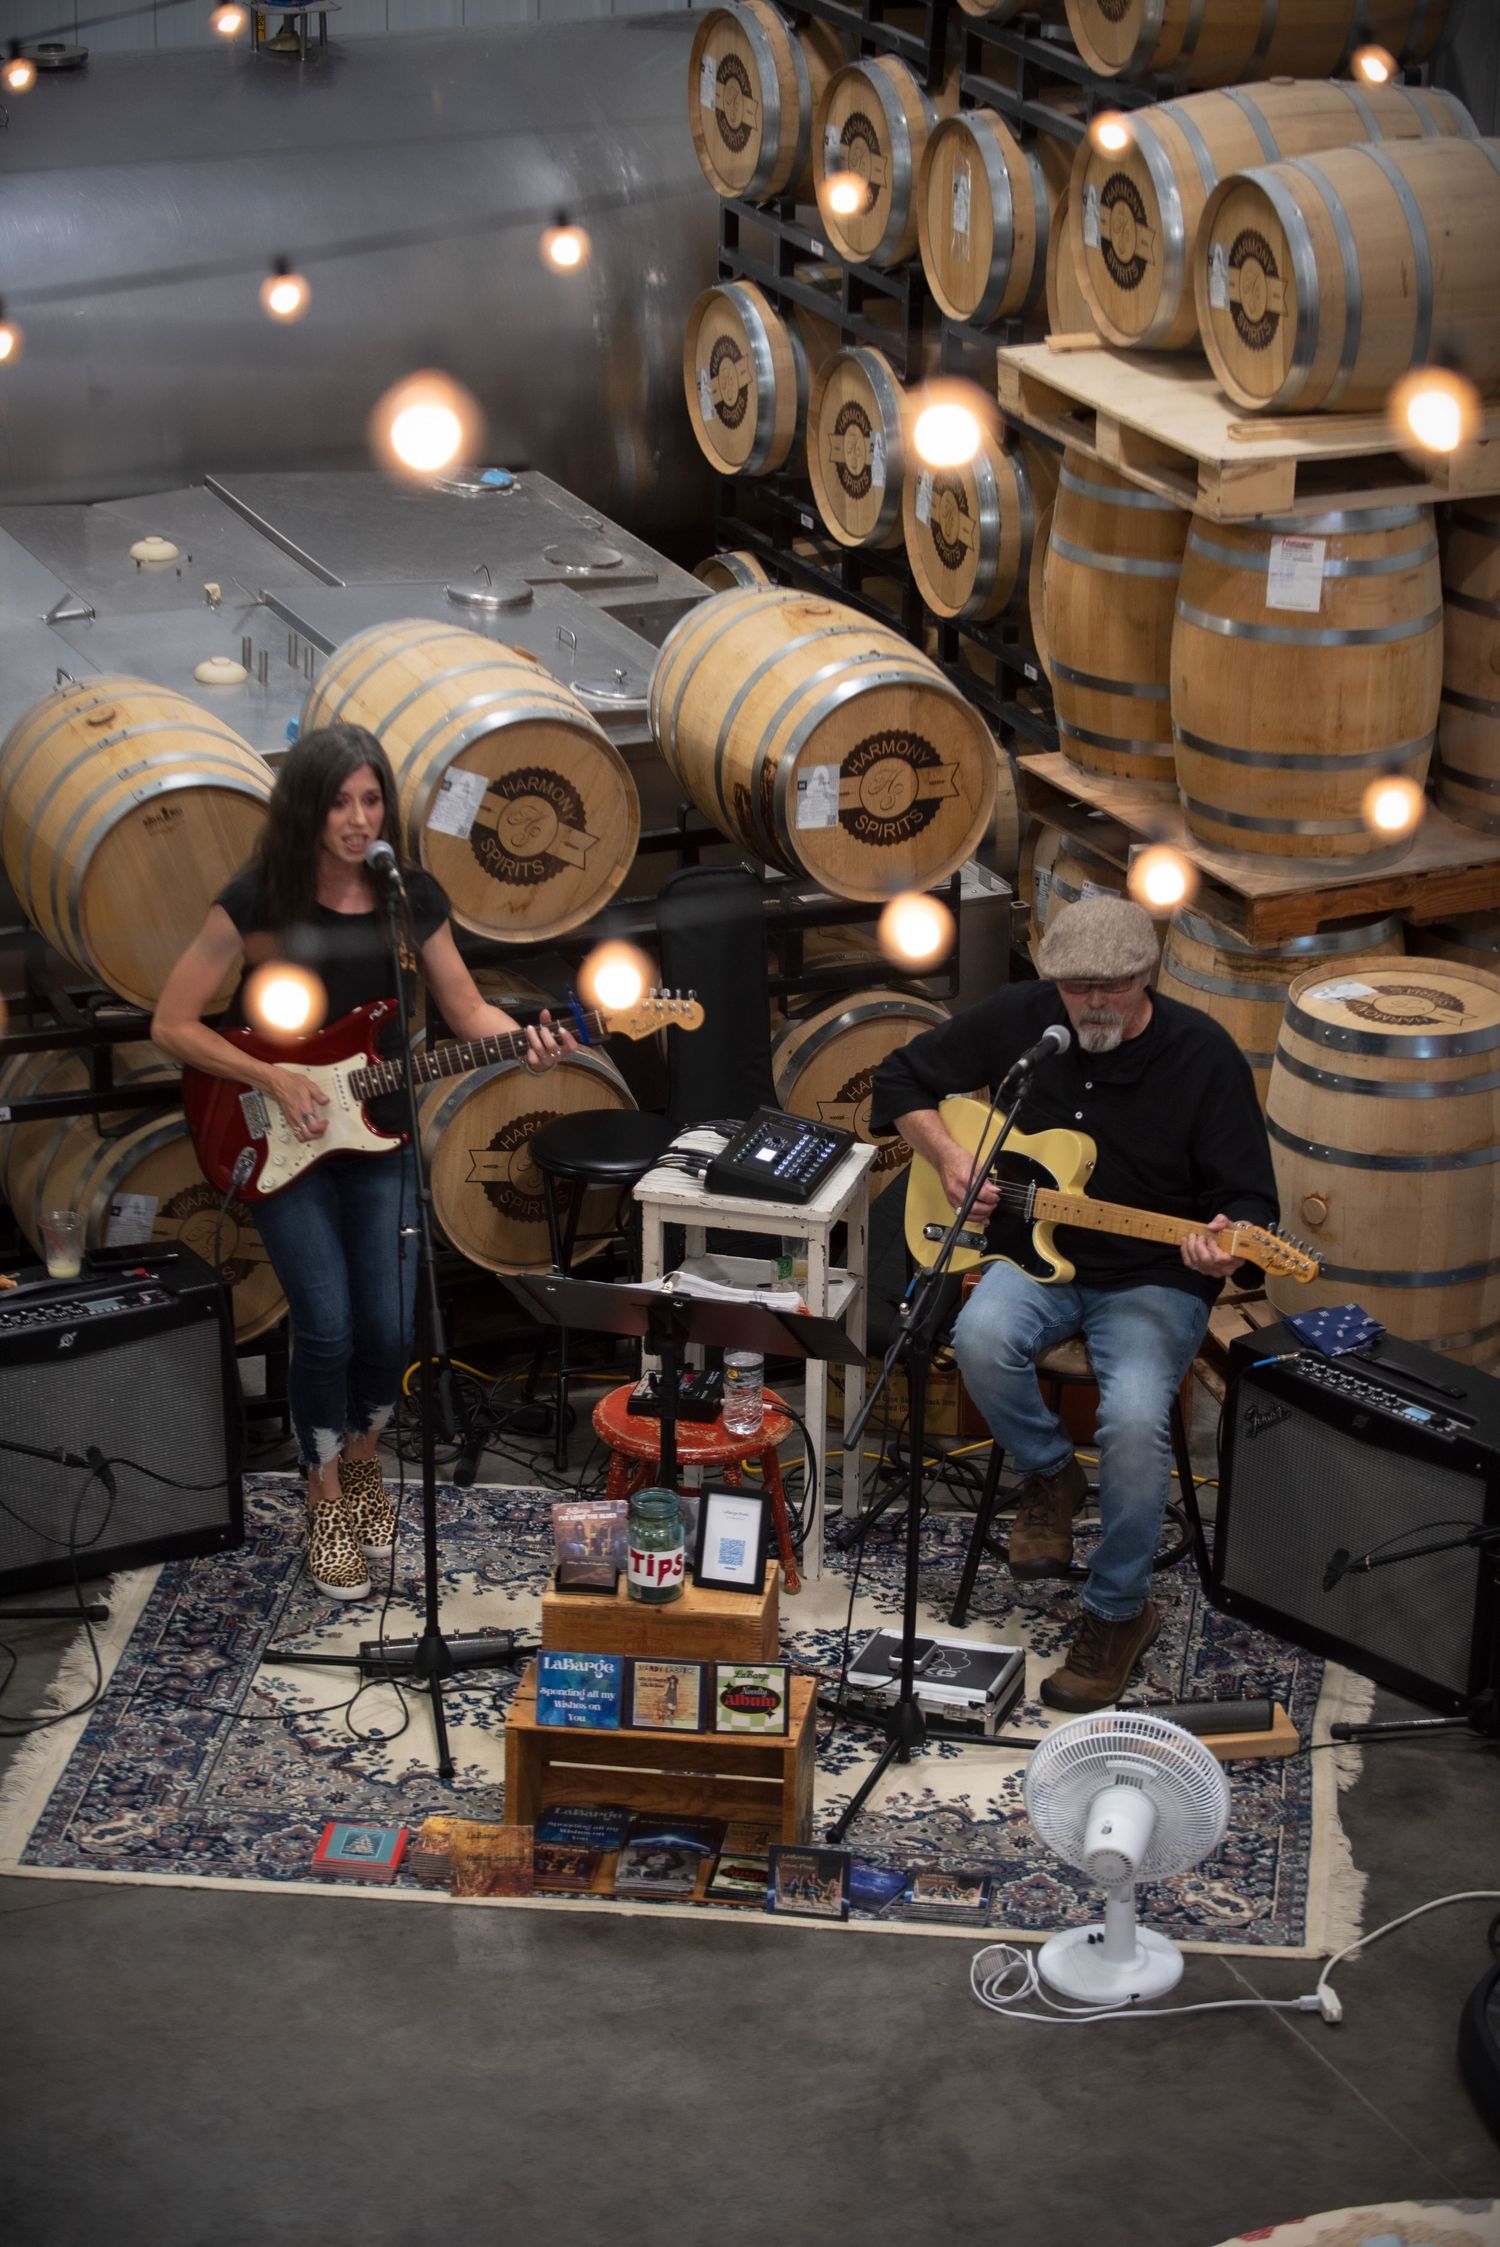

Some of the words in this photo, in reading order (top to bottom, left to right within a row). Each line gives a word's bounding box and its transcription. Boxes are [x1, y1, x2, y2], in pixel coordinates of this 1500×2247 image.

[849, 739, 931, 775] HARMONY
[502, 776, 578, 823] HARMONY
[855, 808, 924, 839] SPIRITS
[480, 838, 545, 878] SPIRITS
[500, 1189, 569, 1215] SPIRIS
[543, 1656, 615, 1679] LaBarge
[539, 1686, 586, 1701] Spending
[586, 1689, 600, 1699] all
[600, 1691, 617, 1701] my
[553, 1699, 587, 1710] Wishes
[588, 1703, 602, 1711] on
[567, 1712, 587, 1723] You
[554, 1807, 623, 1821] LaBarge
